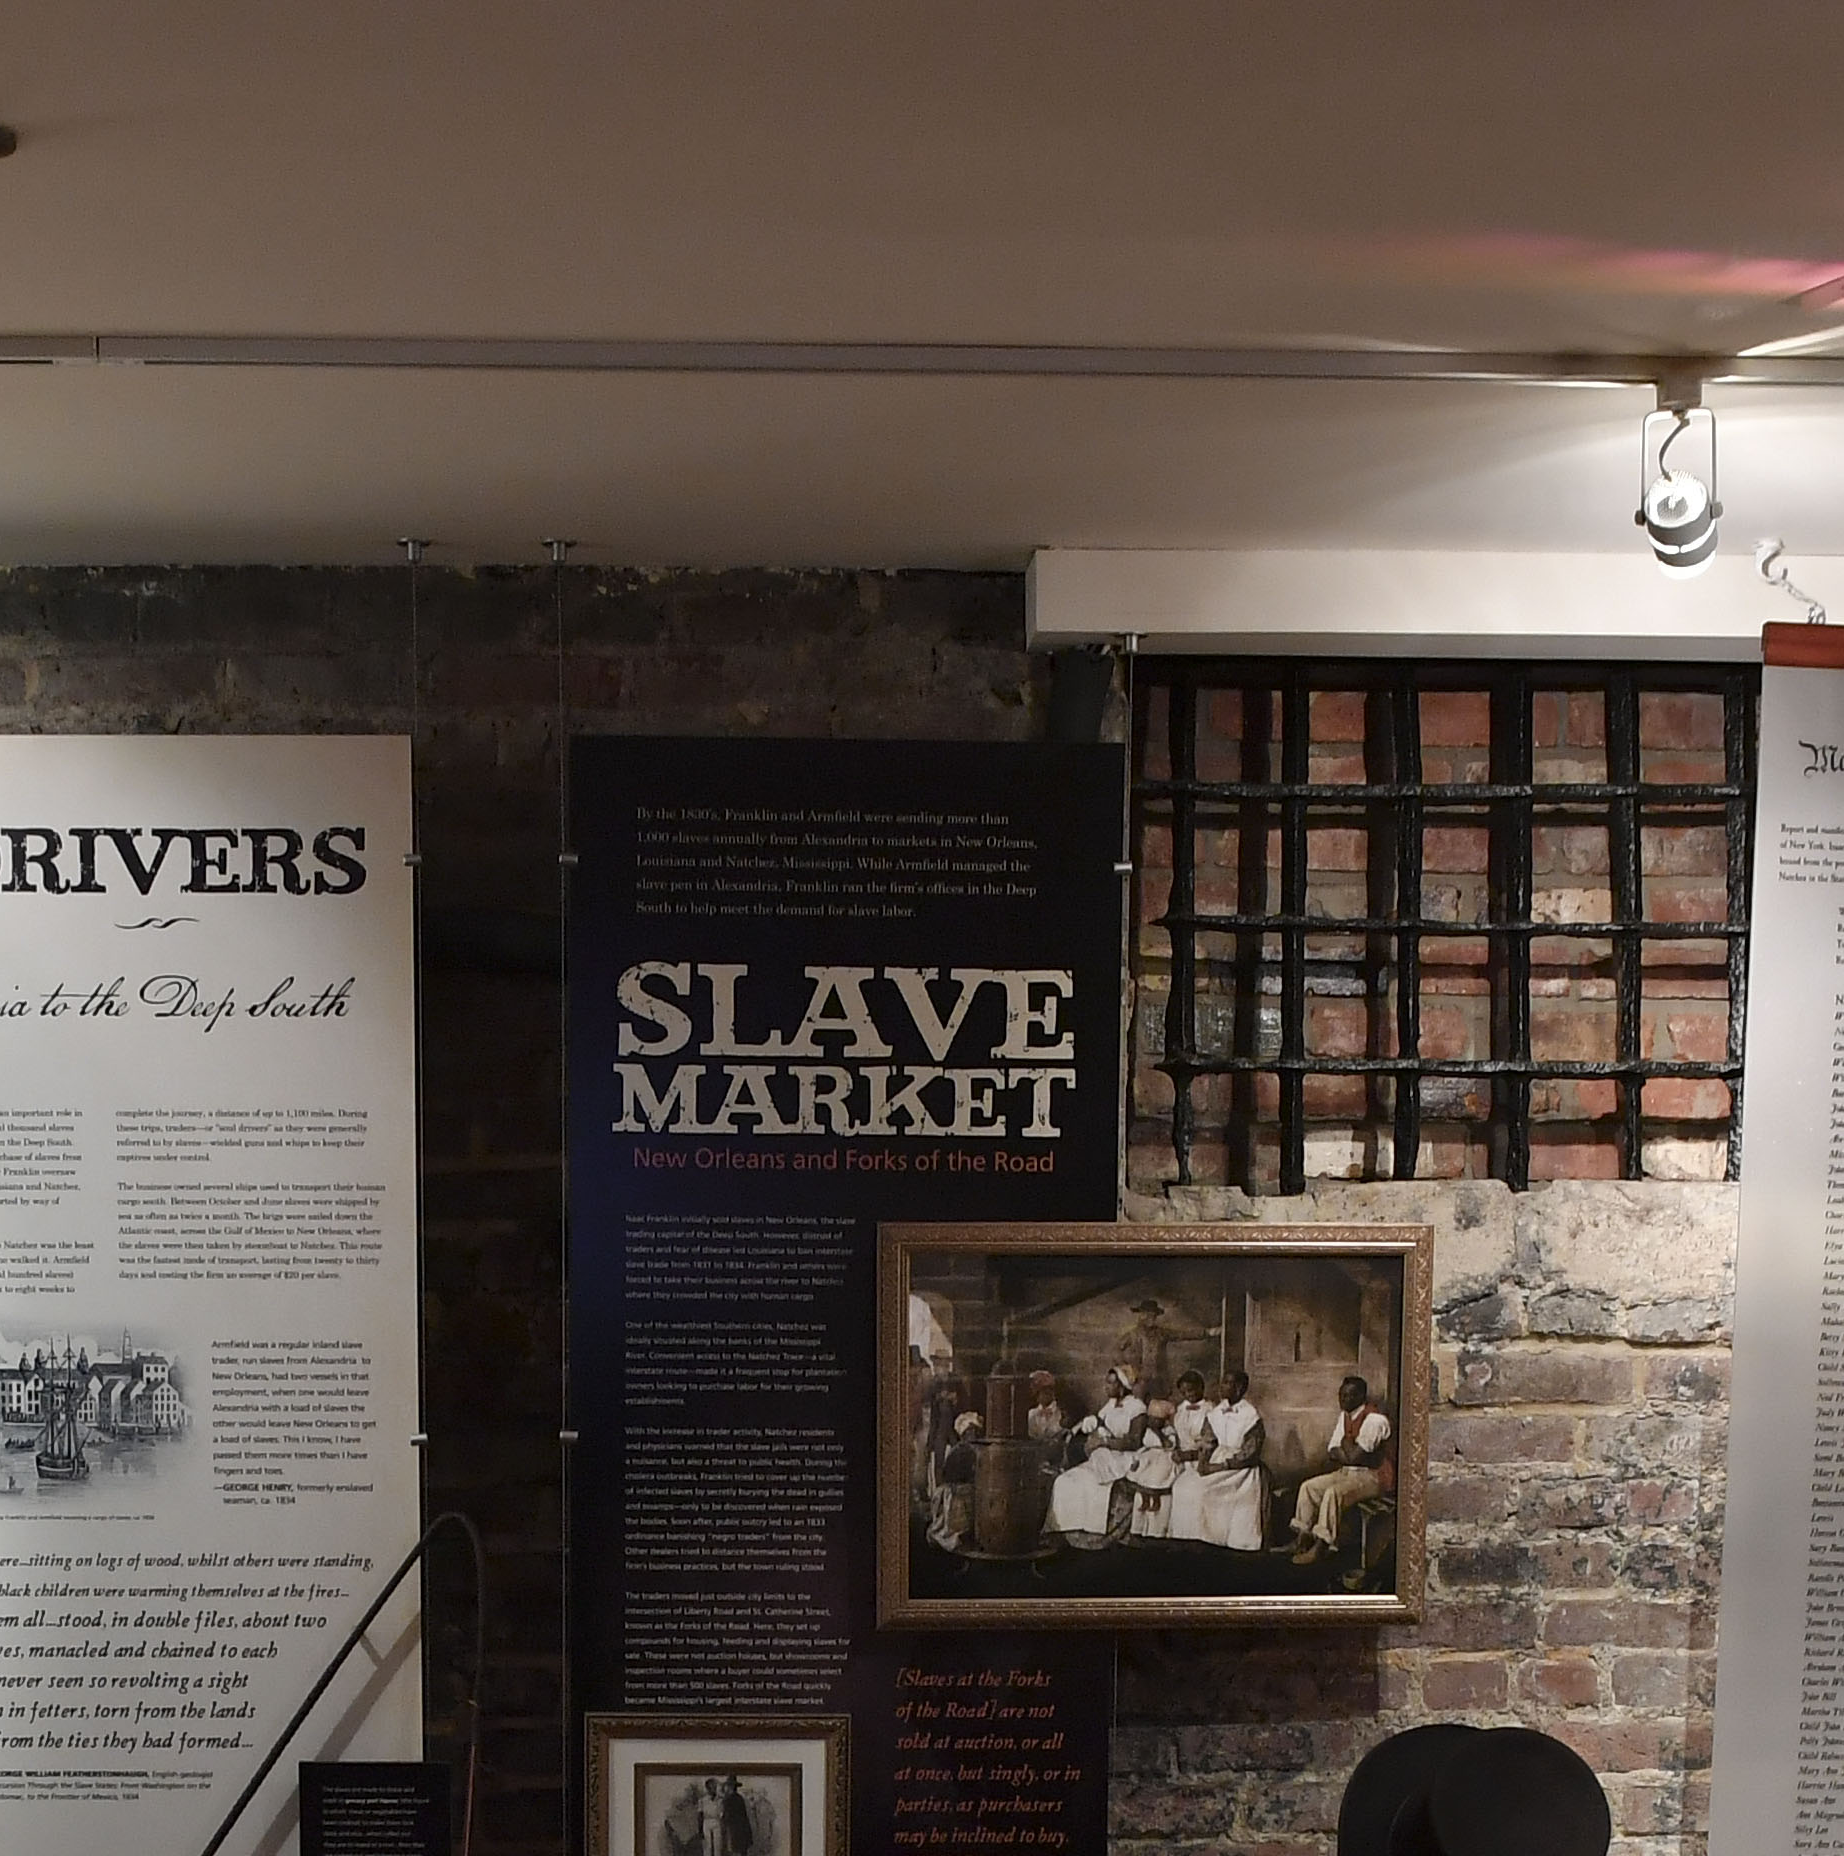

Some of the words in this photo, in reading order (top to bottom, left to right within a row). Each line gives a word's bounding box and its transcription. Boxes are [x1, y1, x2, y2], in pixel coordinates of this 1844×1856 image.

[38, 986, 71, 1018] to
[77, 977, 131, 1019] the
[139, 974, 234, 1035] Deep
[244, 976, 354, 1019] South
[616, 961, 1075, 1061] SLAVE
[612, 1063, 1077, 1137] MARKET
[634, 1147, 687, 1168] New
[695, 1147, 785, 1169] Orleans
[793, 1148, 837, 1170] and
[846, 1149, 907, 1171] Forks
[915, 1149, 940, 1170] of
[947, 1150, 986, 1172] the
[995, 1150, 1053, 1172] Road
[29, 1640, 110, 1658] manacled
[114, 1640, 147, 1657] and
[151, 1640, 216, 1658] chained
[221, 1644, 237, 1658] to
[242, 1641, 277, 1658] each
[48, 1676, 83, 1688] seen
[89, 1677, 107, 1688] so
[111, 1671, 189, 1694] revolting
[193, 1677, 203, 1688] a
[208, 1671, 248, 1694] sight
[957, 1672, 973, 1686] at
[978, 1669, 1002, 1687] the
[1006, 1670, 1051, 1687] Forks
[896, 1702, 913, 1723] of
[917, 1701, 941, 1718] the
[999, 1707, 1025, 1718] are
[1028, 1704, 1055, 1718] not
